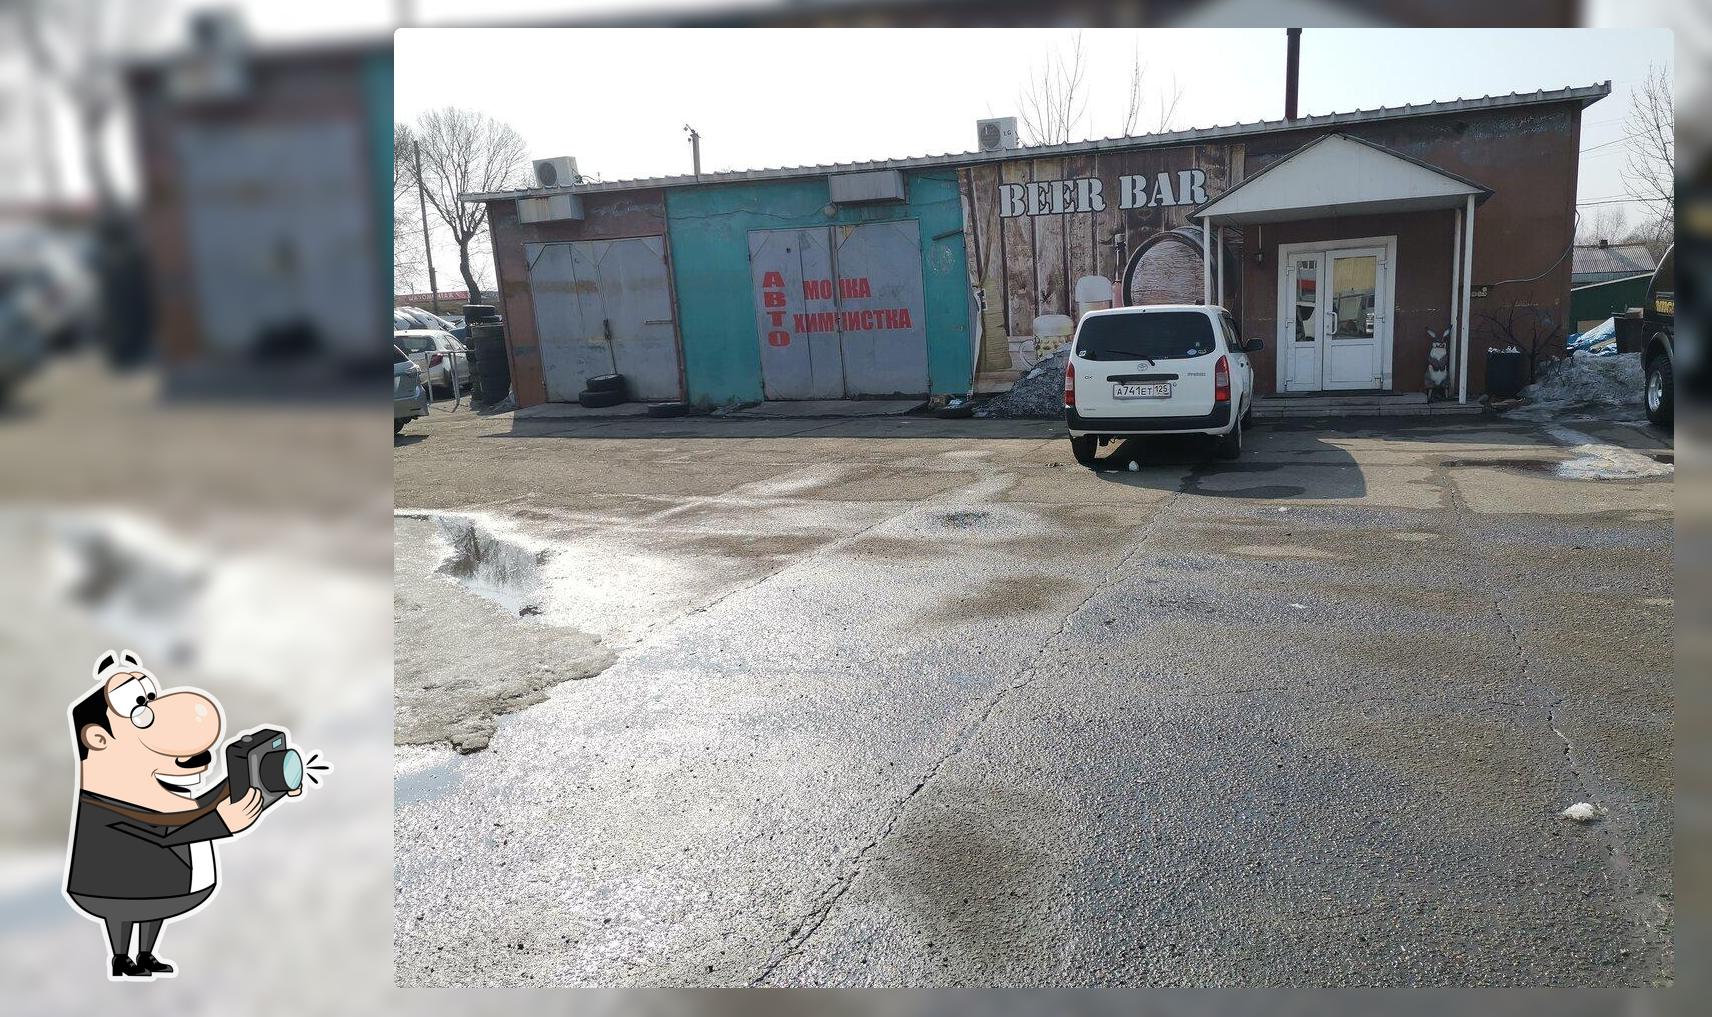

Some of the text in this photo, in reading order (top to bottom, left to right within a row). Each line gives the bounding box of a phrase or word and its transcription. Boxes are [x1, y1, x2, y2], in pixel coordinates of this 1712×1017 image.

[998, 168, 1209, 218] BEER BAR
[763, 271, 791, 347] АВТО
